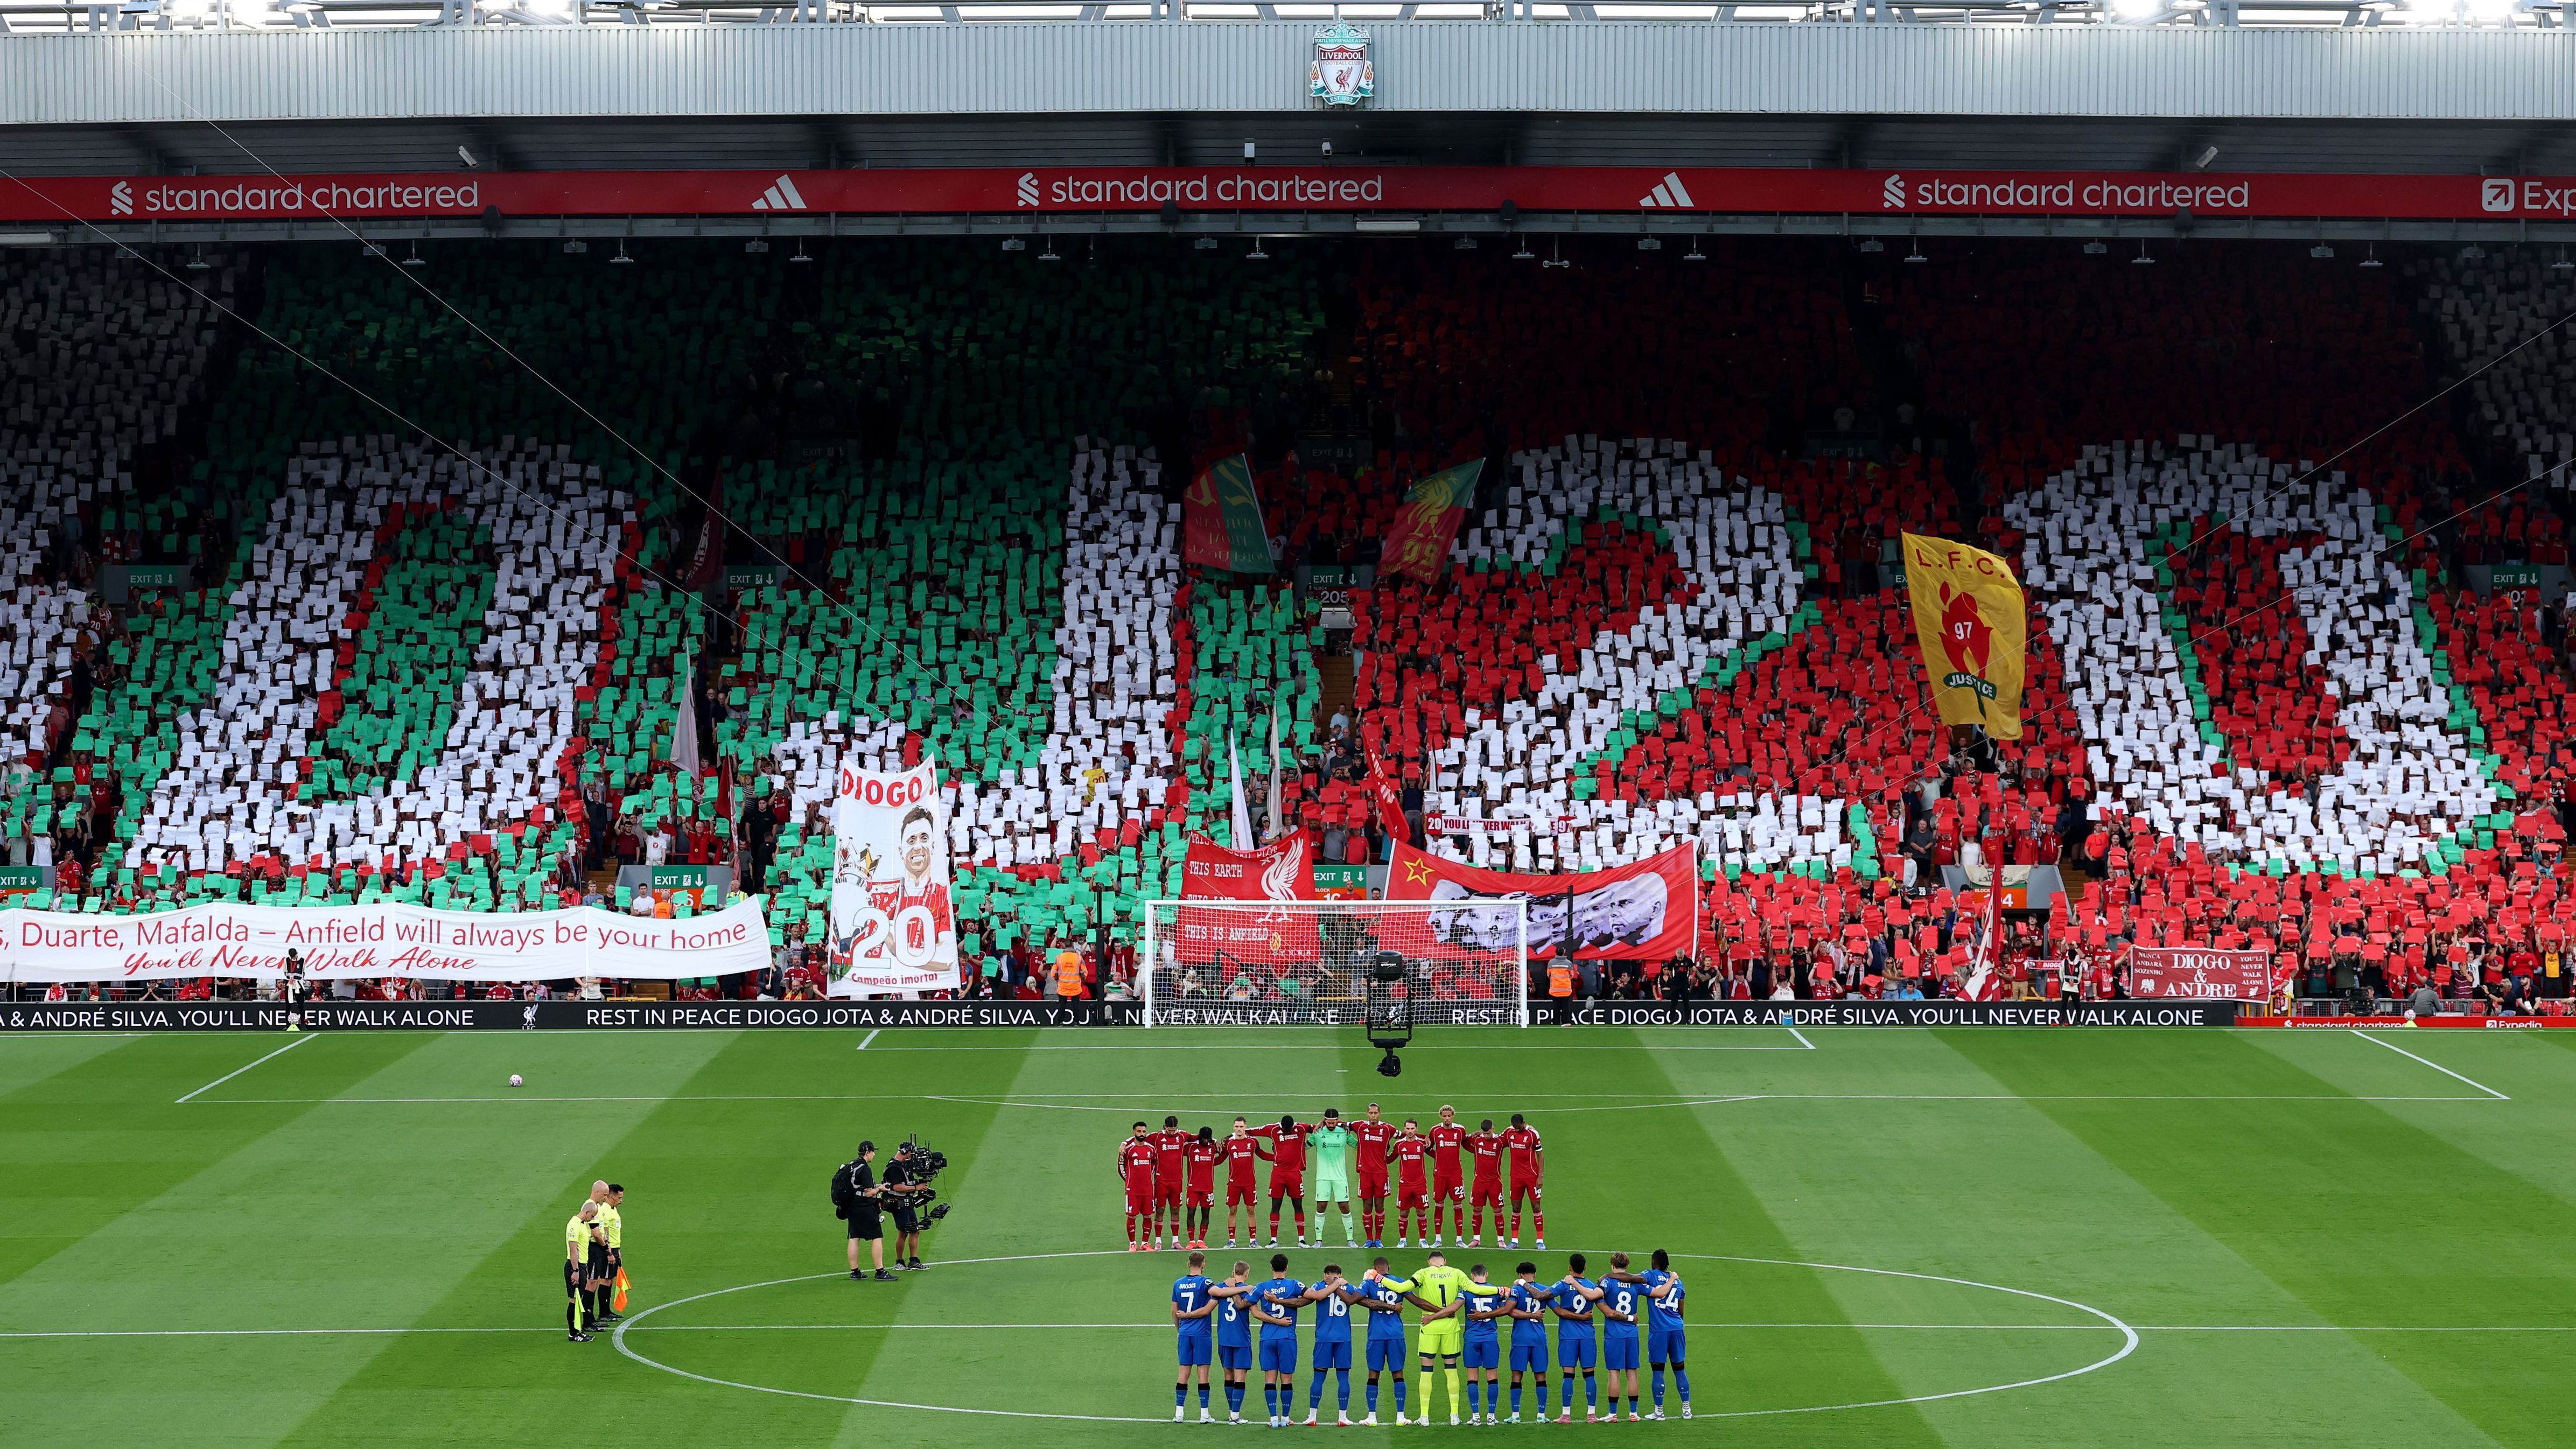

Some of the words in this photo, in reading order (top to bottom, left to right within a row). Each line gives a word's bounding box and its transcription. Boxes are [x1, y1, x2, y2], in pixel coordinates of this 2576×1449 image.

[1321, 52, 1363, 60] LIVERPOOL
[145, 183, 302, 212] standard
[312, 180, 479, 209] chartered
[1052, 174, 1207, 202] standard
[1217, 174, 1382, 201] chartered
[1917, 178, 2073, 206] standard
[2083, 179, 2249, 207] chartered
[2524, 181, 2576, 216] Exp
[1312, 449, 1331, 457] EXIT
[1915, 548, 2005, 579] L.F.C.
[130, 575, 152, 584] EXIT
[730, 575, 751, 584] EXIT
[1313, 575, 1334, 584] EXIT
[1895, 575, 1908, 583] EX
[2493, 574, 2514, 583] EXIT
[1321, 590, 1348, 604] 205
[90, 620, 100, 631] 20
[1955, 621, 1972, 640] 97
[842, 768, 922, 807] DIOGO
[1427, 817, 1442, 830] 20
[1189, 861, 1210, 876] THIS
[1214, 863, 1243, 878] EARTH
[1314, 872, 1336, 881] EXIT
[0, 877, 17, 885] XIT
[655, 876, 678, 885] EXIT
[22, 922, 123, 950] Duarte,
[137, 915, 249, 946] Mafalda
[285, 915, 384, 944] Anfield
[395, 919, 441, 944] will
[453, 921, 545, 953] always
[555, 920, 588, 944] be
[598, 925, 661, 950] your
[671, 922, 746, 949] home
[852, 905, 936, 969] 20
[1185, 925, 1208, 939] THIS
[1213, 926, 1224, 940] IS
[1229, 928, 1269, 941] ANFIELD
[123, 946, 203, 976] You'll
[211, 944, 286, 970] Never
[304, 947, 380, 971] Walk
[388, 946, 479, 970] Alone
[2138, 951, 2161, 960] NUNCA
[2171, 953, 2231, 970] DIOGO
[2134, 968, 2164, 976] SOZINHO
[2136, 960, 2163, 968] ANDARÁ
[851, 973, 898, 985] Campeão
[2194, 968, 2207, 983] &
[2163, 982, 2237, 997] ANDRE
[10, 1011, 25, 1027] &
[30, 1007, 105, 1027] ANDRÉ
[111, 1011, 173, 1027] SILVA.
[178, 1010, 253, 1026] YOU'LL
[258, 1010, 331, 1026] NEER
[336, 1010, 397, 1026] WALK
[400, 1010, 474, 1026] ALONE
[586, 1009, 640, 1025] REST
[645, 1009, 666, 1025] IN
[672, 1009, 741, 1025] PEACE
[747, 1009, 818, 1025] DIOGO
[823, 1009, 875, 1025] JOTA
[881, 1009, 894, 1025] &
[898, 1005, 974, 1025] ANDRÉ
[979, 1009, 1040, 1025] SILVA.
[1202, 1009, 1262, 1025] WALK
[1452, 1009, 1506, 1025] REST
[1612, 1009, 1682, 1025] DIOGO
[1690, 1009, 1738, 1025] JOTA
[1745, 1009, 1760, 1025] &
[1763, 1005, 1837, 1025] ANDRÉ
[1843, 1009, 1903, 1025] SILVA.
[1909, 1009, 1983, 1025] YOU'LL
[1989, 1009, 2060, 1025] NEVER
[2067, 1009, 2127, 1025] WALK
[2130, 1009, 2204, 1025] ALONE
[1300, 1182, 1304, 1192] 5
[1454, 1186, 1464, 1195] 22
[1206, 1193, 1214, 1202] 30
[1421, 1194, 1429, 1203] 10
[1498, 1192, 1503, 1201] 6
[1617, 1281, 1632, 1289] SCOTT
[1181, 1291, 1194, 1314] 7
[1439, 1284, 1447, 1308] 1
[1573, 1294, 1586, 1314] 9
[1615, 1291, 1632, 1315] 8
[1655, 1285, 1678, 1312] 24
[1224, 1297, 1236, 1322] 3
[1271, 1297, 1285, 1319] 5
[1327, 1292, 1347, 1317] 16
[1472, 1297, 1493, 1322] 15
